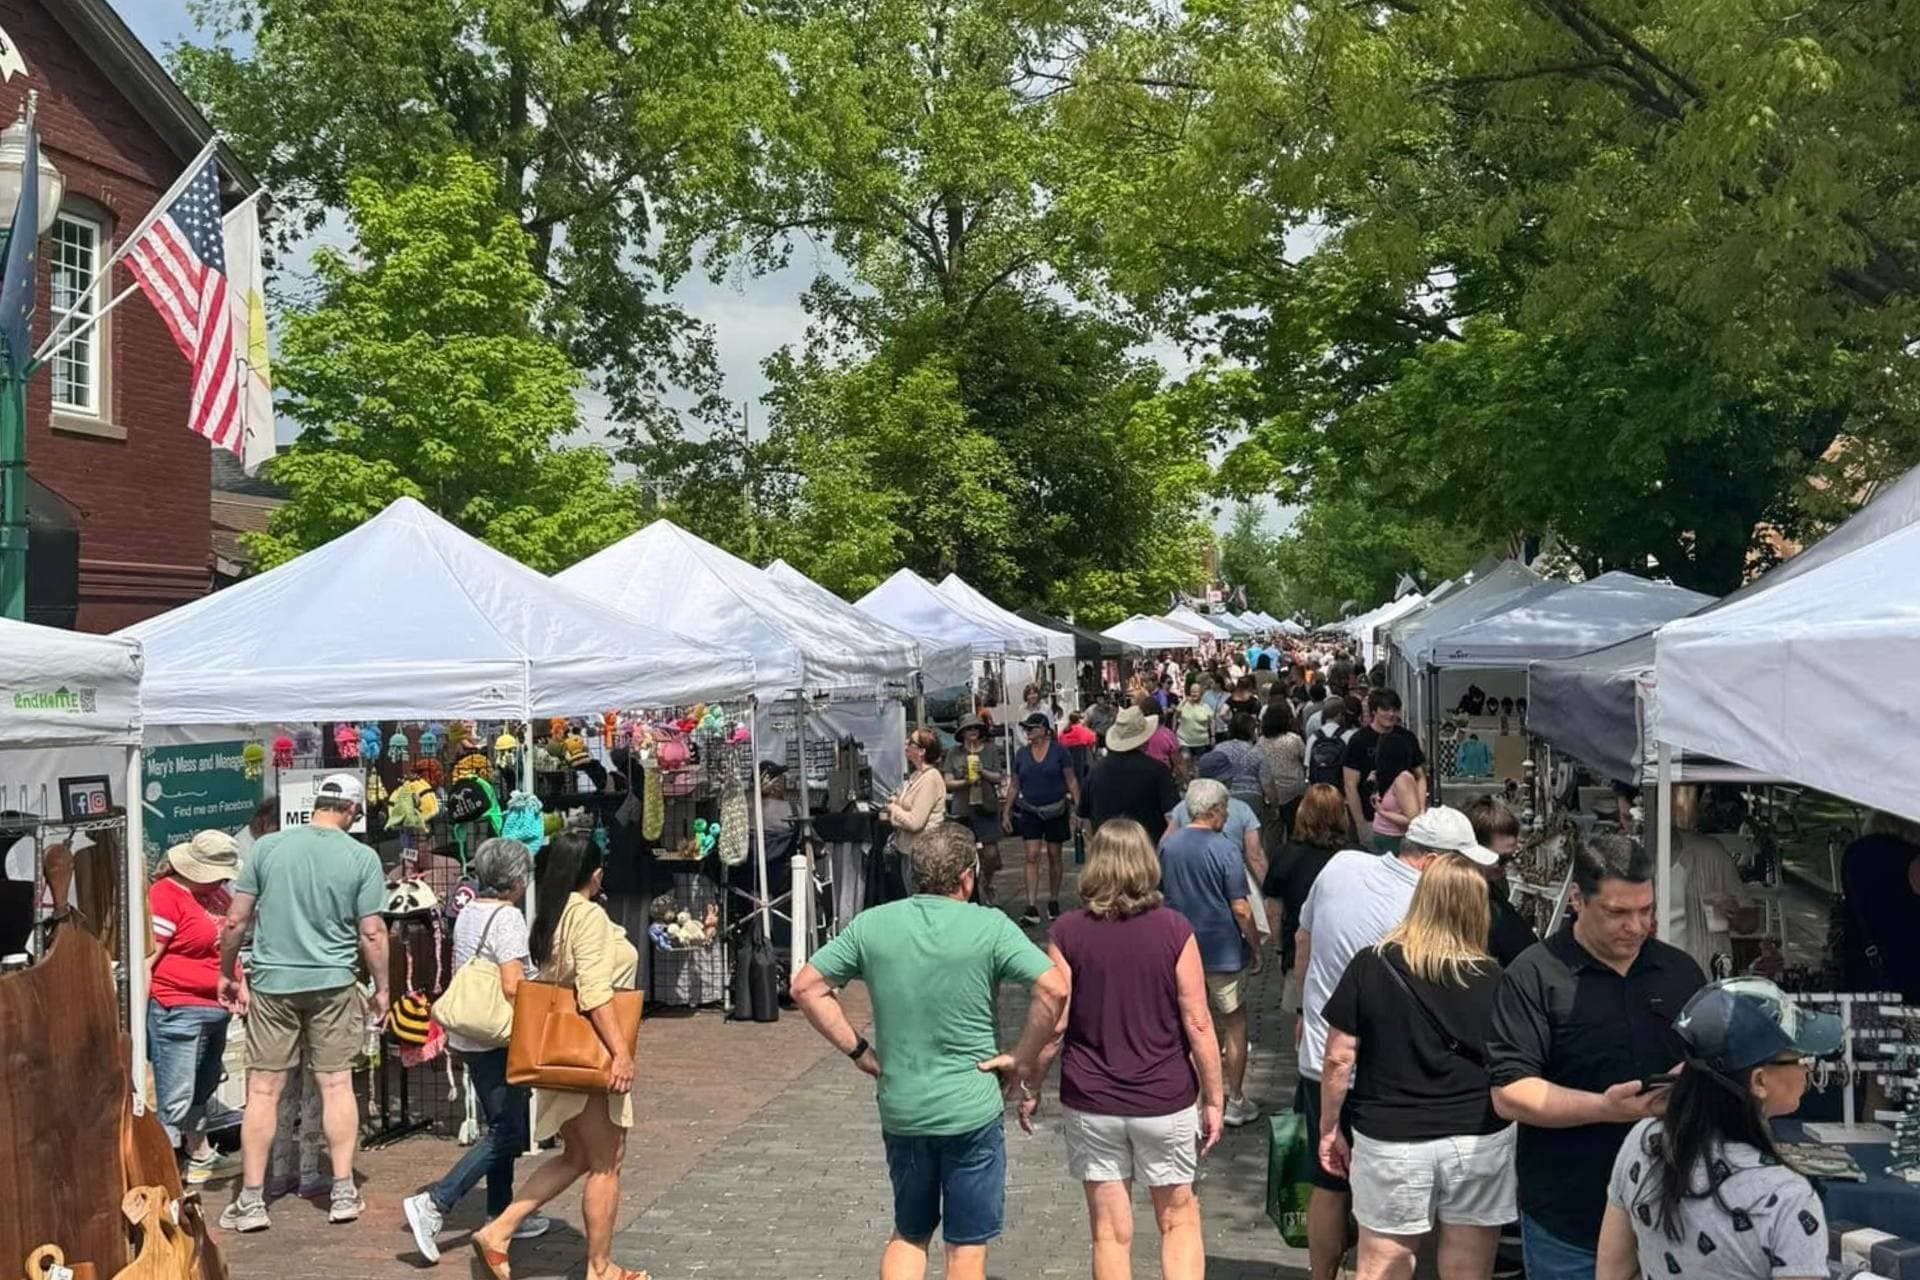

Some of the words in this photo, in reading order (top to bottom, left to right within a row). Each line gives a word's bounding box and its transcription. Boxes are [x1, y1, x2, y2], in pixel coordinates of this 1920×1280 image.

[147, 757, 174, 779] Mary's
[199, 752, 214, 772] and
[173, 804, 192, 818] Find
[193, 805, 206, 816] me
[207, 803, 218, 814] on
[219, 799, 255, 812] Facebook
